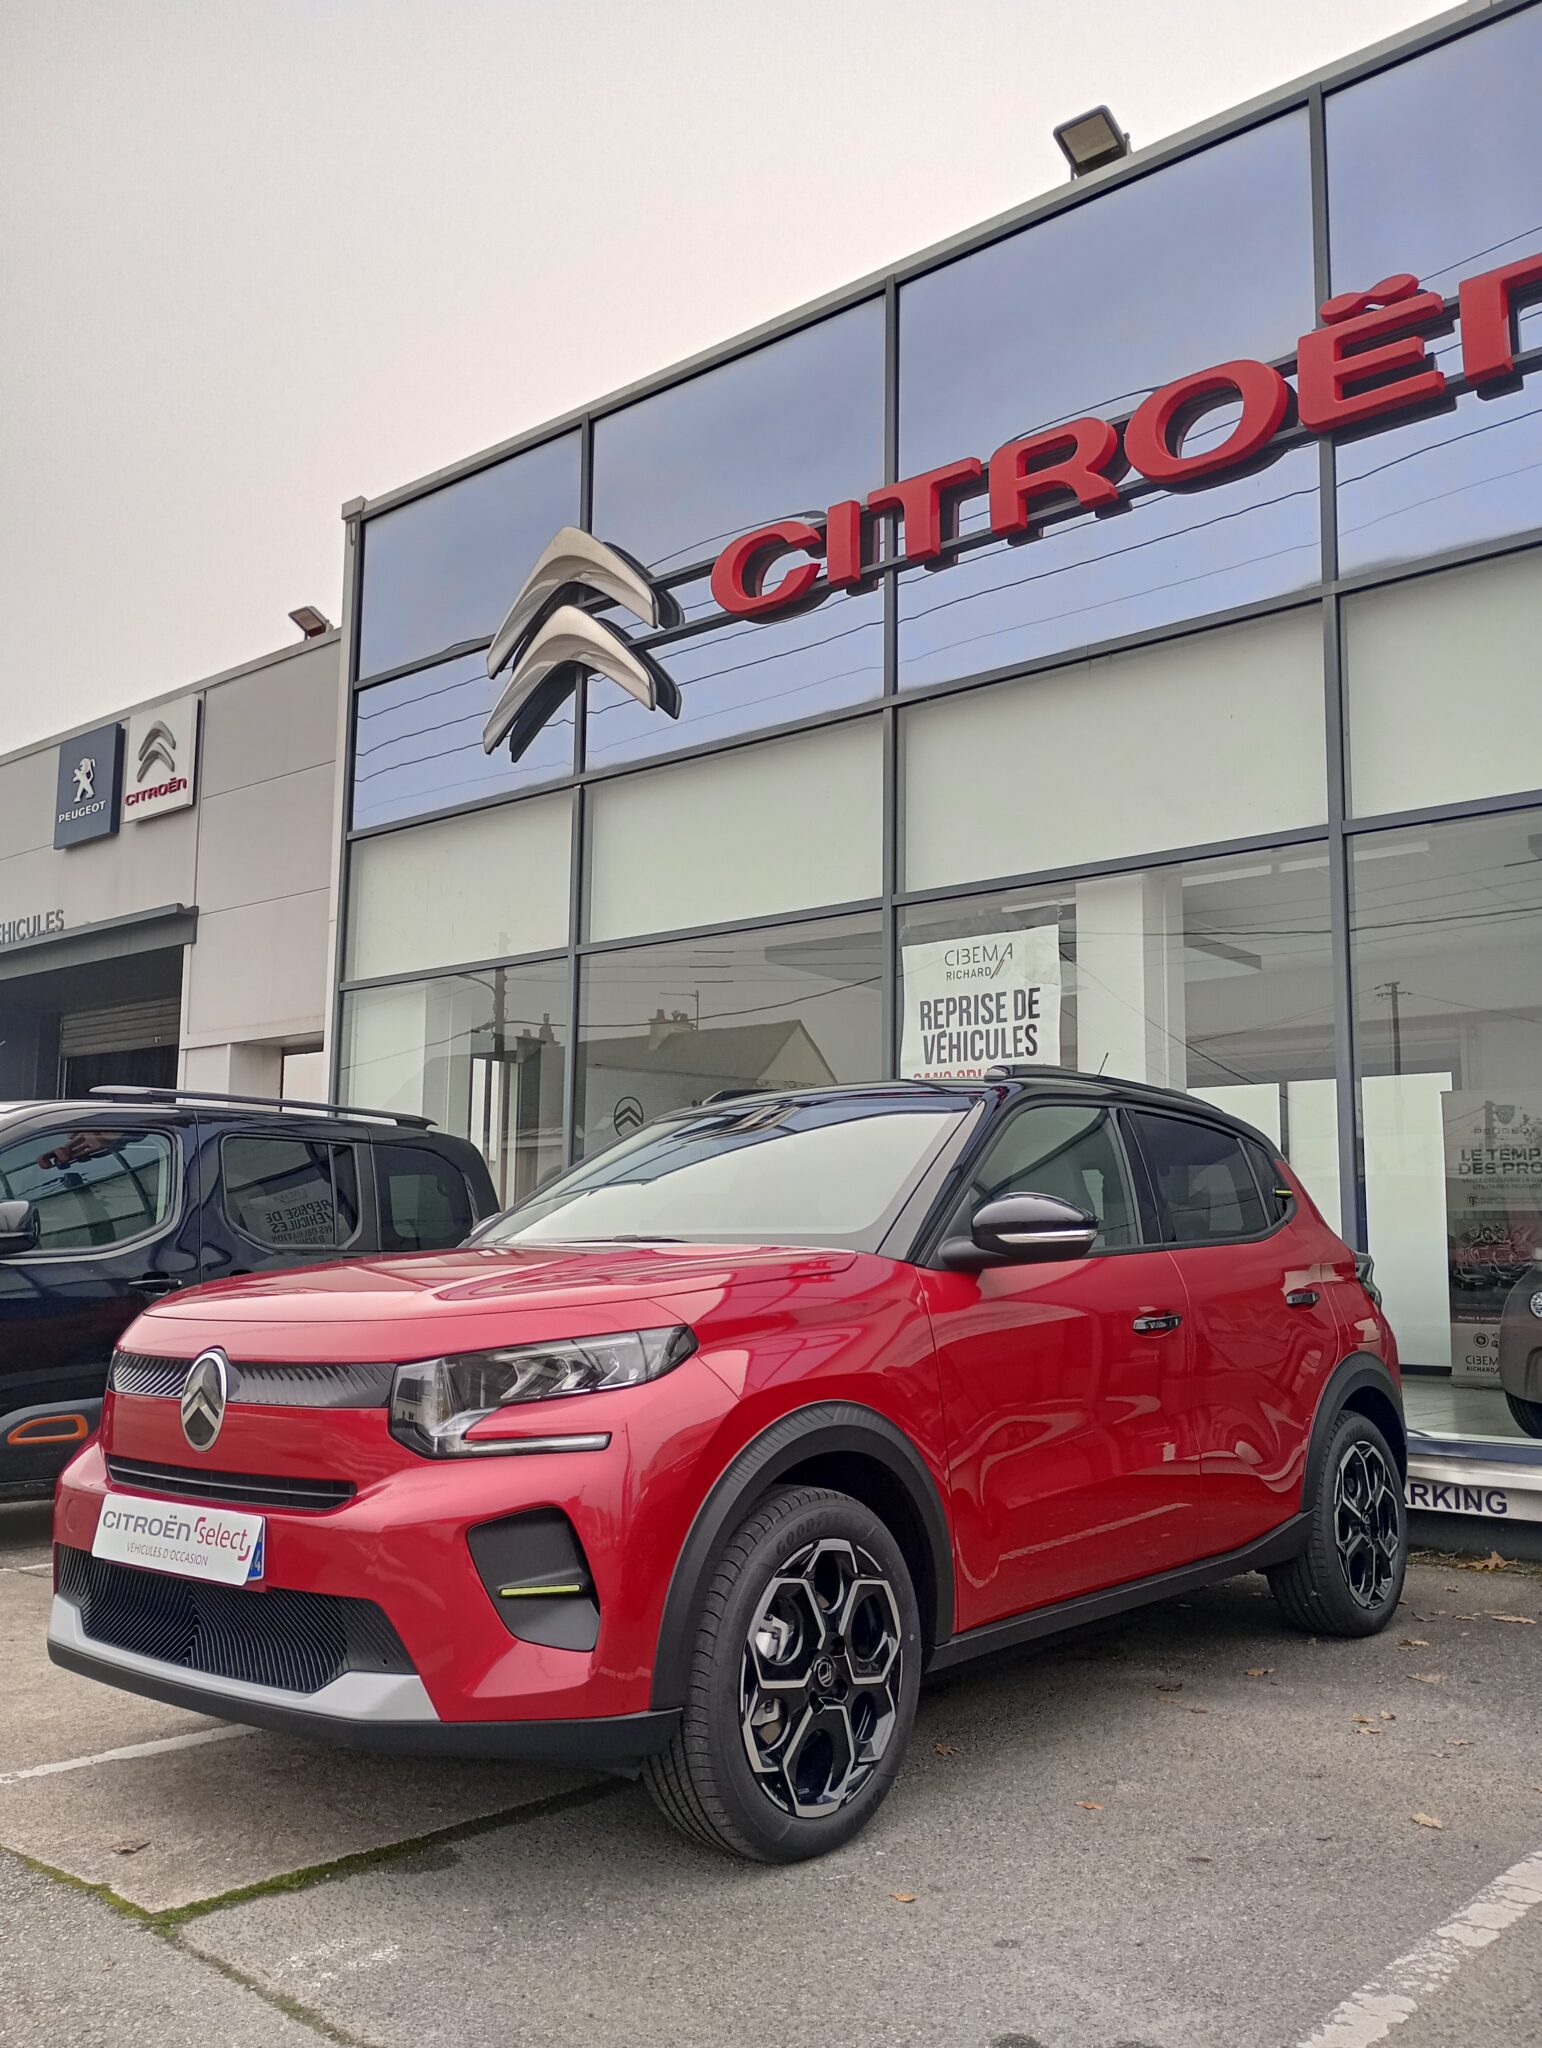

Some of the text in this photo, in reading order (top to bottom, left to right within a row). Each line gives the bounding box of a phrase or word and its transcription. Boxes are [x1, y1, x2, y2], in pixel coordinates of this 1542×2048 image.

[58, 800, 107, 823] PEUGEOT
[0, 909, 65, 945] HICULES
[946, 966, 991, 981] RICHARD
[919, 987, 1041, 1031] REPRISE DE
[923, 1023, 1038, 1065] VÉHICULES
[1461, 1149, 1482, 1162] LE
[1459, 1162, 1496, 1175] DES
[1466, 1365, 1494, 1373] RICHARD
[1404, 1483, 1508, 1515] RKING
